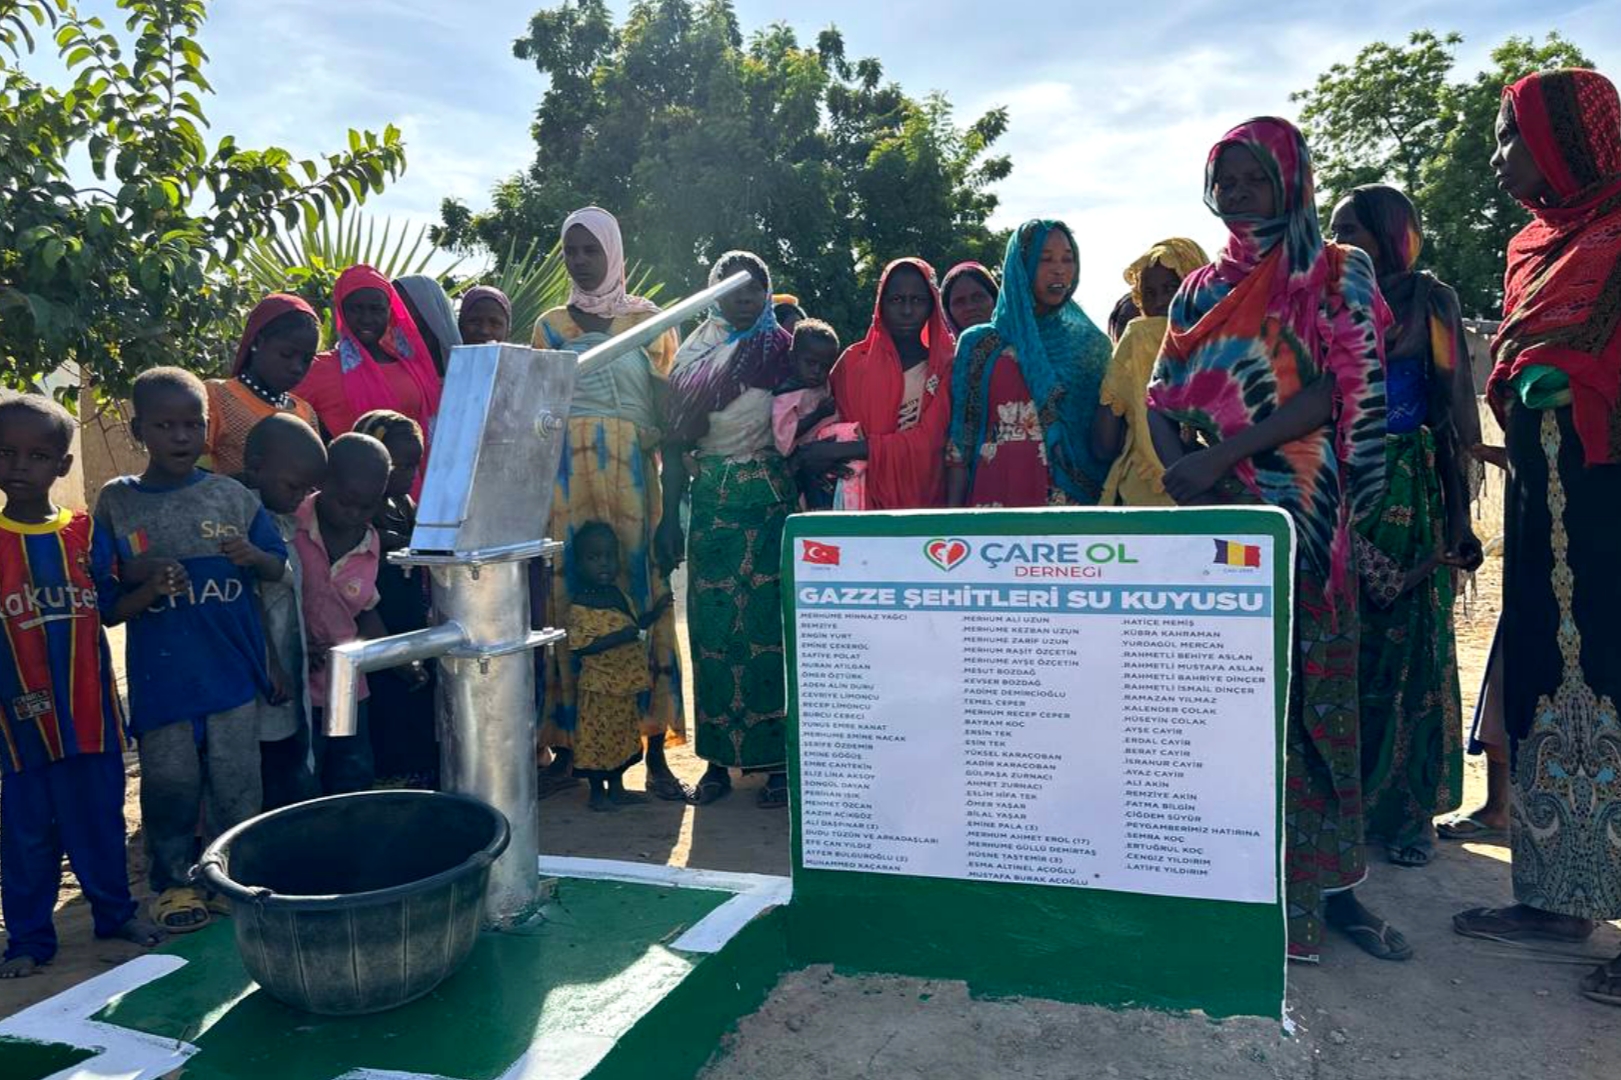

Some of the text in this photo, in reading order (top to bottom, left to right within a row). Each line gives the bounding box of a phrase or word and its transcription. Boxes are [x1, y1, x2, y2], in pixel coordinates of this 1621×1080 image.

[980, 543, 1140, 568] ÇARE OL
[0, 583, 107, 618] akute
[799, 585, 1264, 611] GAZZE ŞEHİTLERİ SU KUYUSU
